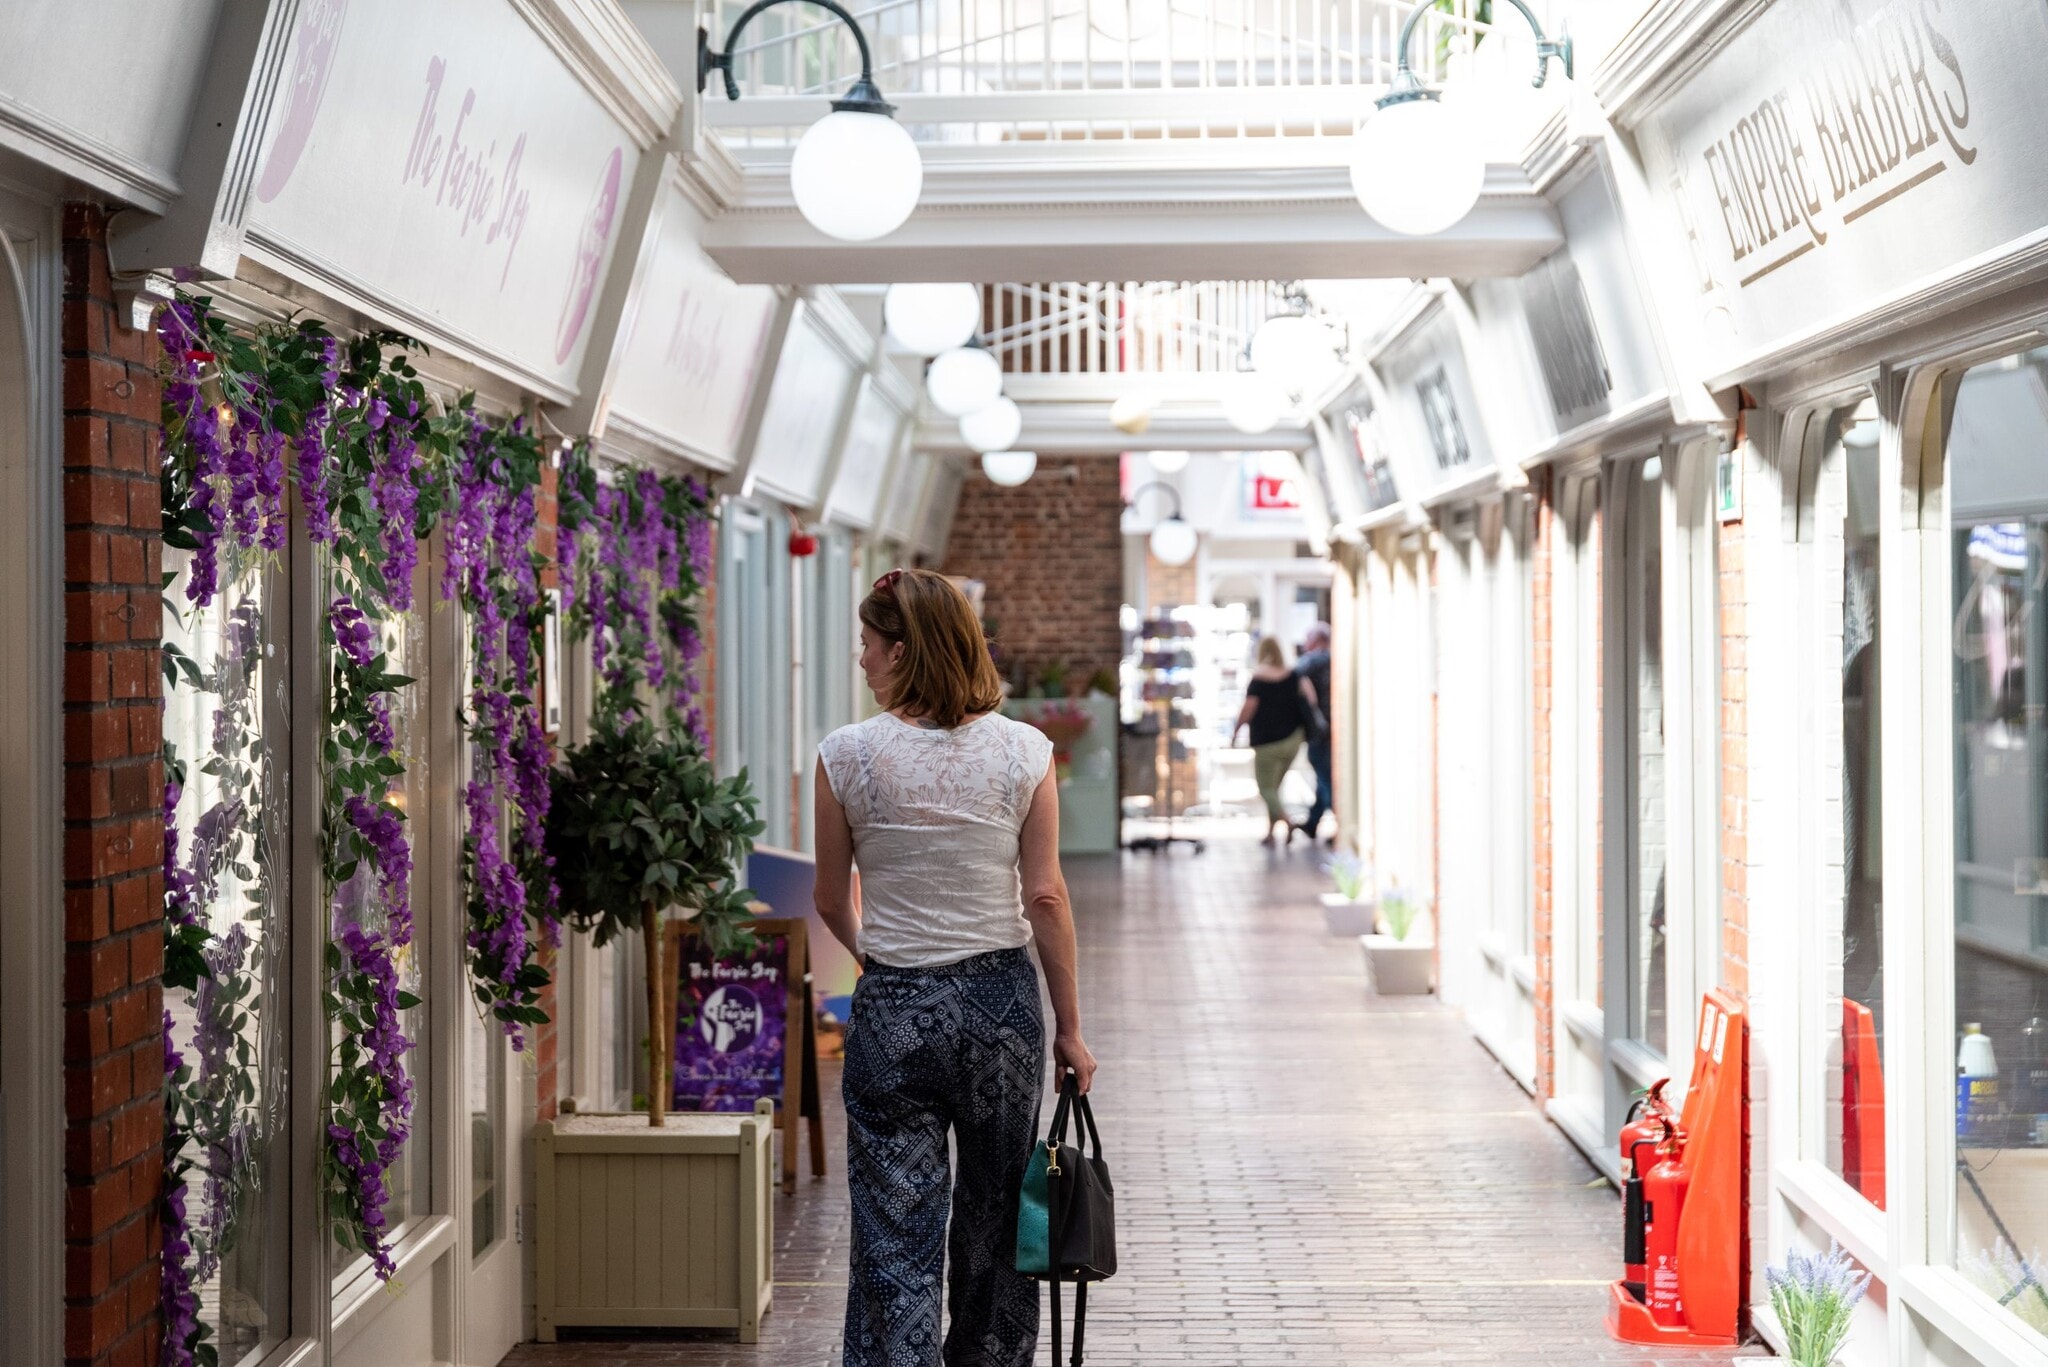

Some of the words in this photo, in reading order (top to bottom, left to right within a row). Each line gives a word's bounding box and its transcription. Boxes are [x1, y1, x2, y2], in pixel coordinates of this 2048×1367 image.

[402, 55, 446, 188] The
[436, 88, 496, 238] Faerie
[1703, 87, 1828, 262] EMPIRE
[1800, 0, 1977, 203] BARBERS
[688, 962, 710, 979] The
